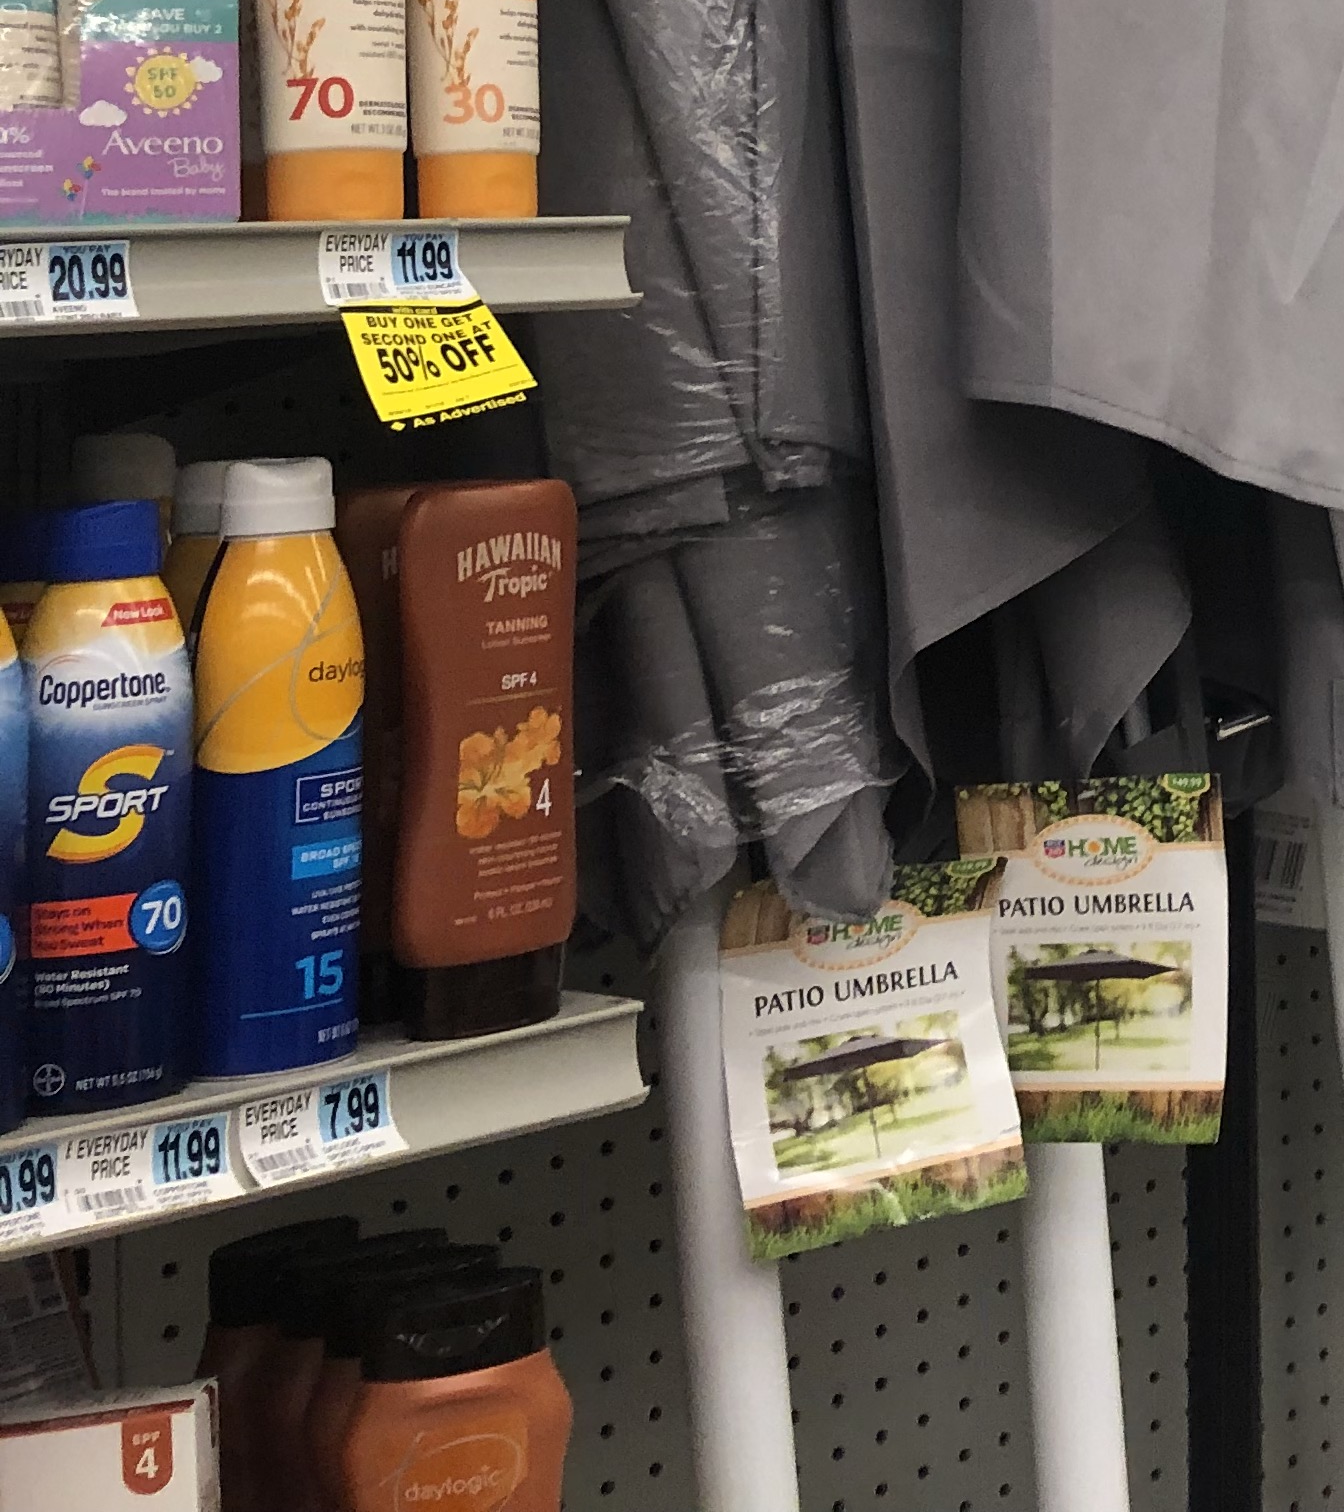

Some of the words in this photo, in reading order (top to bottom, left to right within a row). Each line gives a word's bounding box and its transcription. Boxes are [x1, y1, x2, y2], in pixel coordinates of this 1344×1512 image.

[183, 23, 211, 35] BUY
[213, 23, 224, 35] 2
[147, 67, 179, 82] SPF
[285, 75, 355, 121] 70
[442, 82, 506, 126] 30
[101, 128, 225, 157] Aveeno
[167, 155, 225, 182] Baby
[325, 232, 389, 253] EVERYDAY
[48, 252, 129, 302] 20.99
[339, 254, 375, 274] PRICE
[396, 240, 454, 284] 11.99
[360, 332, 428, 347] SECOND
[431, 328, 467, 345] ONE
[471, 320, 494, 336] AT
[365, 315, 399, 329] BUY
[403, 315, 438, 330] ONE
[440, 312, 474, 329] GET
[376, 345, 442, 385] 50%
[440, 332, 497, 372] OFF
[412, 415, 437, 430] As
[439, 391, 528, 424] Advertised
[456, 531, 563, 583] HAWAIIAN
[476, 564, 549, 603] Tropic
[112, 606, 141, 621] New
[485, 614, 549, 636] TANNING
[38, 670, 166, 711] Coppertone
[501, 672, 529, 691] SPF
[528, 670, 538, 687] 4
[45, 784, 170, 825] SPORT
[535, 777, 553, 817] 4
[1067, 835, 1138, 859] HOME
[141, 894, 182, 936] 70
[998, 895, 1065, 919] PATIO
[1073, 891, 1196, 916] UMBRELLA
[831, 913, 905, 943] HOME
[34, 970, 69, 984] Water
[70, 963, 131, 981] Resistant
[55, 978, 111, 995] Minutes)
[295, 949, 344, 1000] 15
[754, 985, 825, 1019] PATIO
[833, 959, 960, 1004] UMBRELLA
[245, 1090, 313, 1128] EVERYDAY
[260, 1117, 299, 1145] PRICE
[323, 1082, 381, 1140] 7.99
[77, 1128, 149, 1160] EVERYDAY
[90, 1156, 131, 1181] PRICE
[158, 1126, 221, 1184] 11.99
[131, 1430, 161, 1446] SPF
[134, 1446, 160, 1480] 4
[404, 1463, 505, 1502] daylogic
